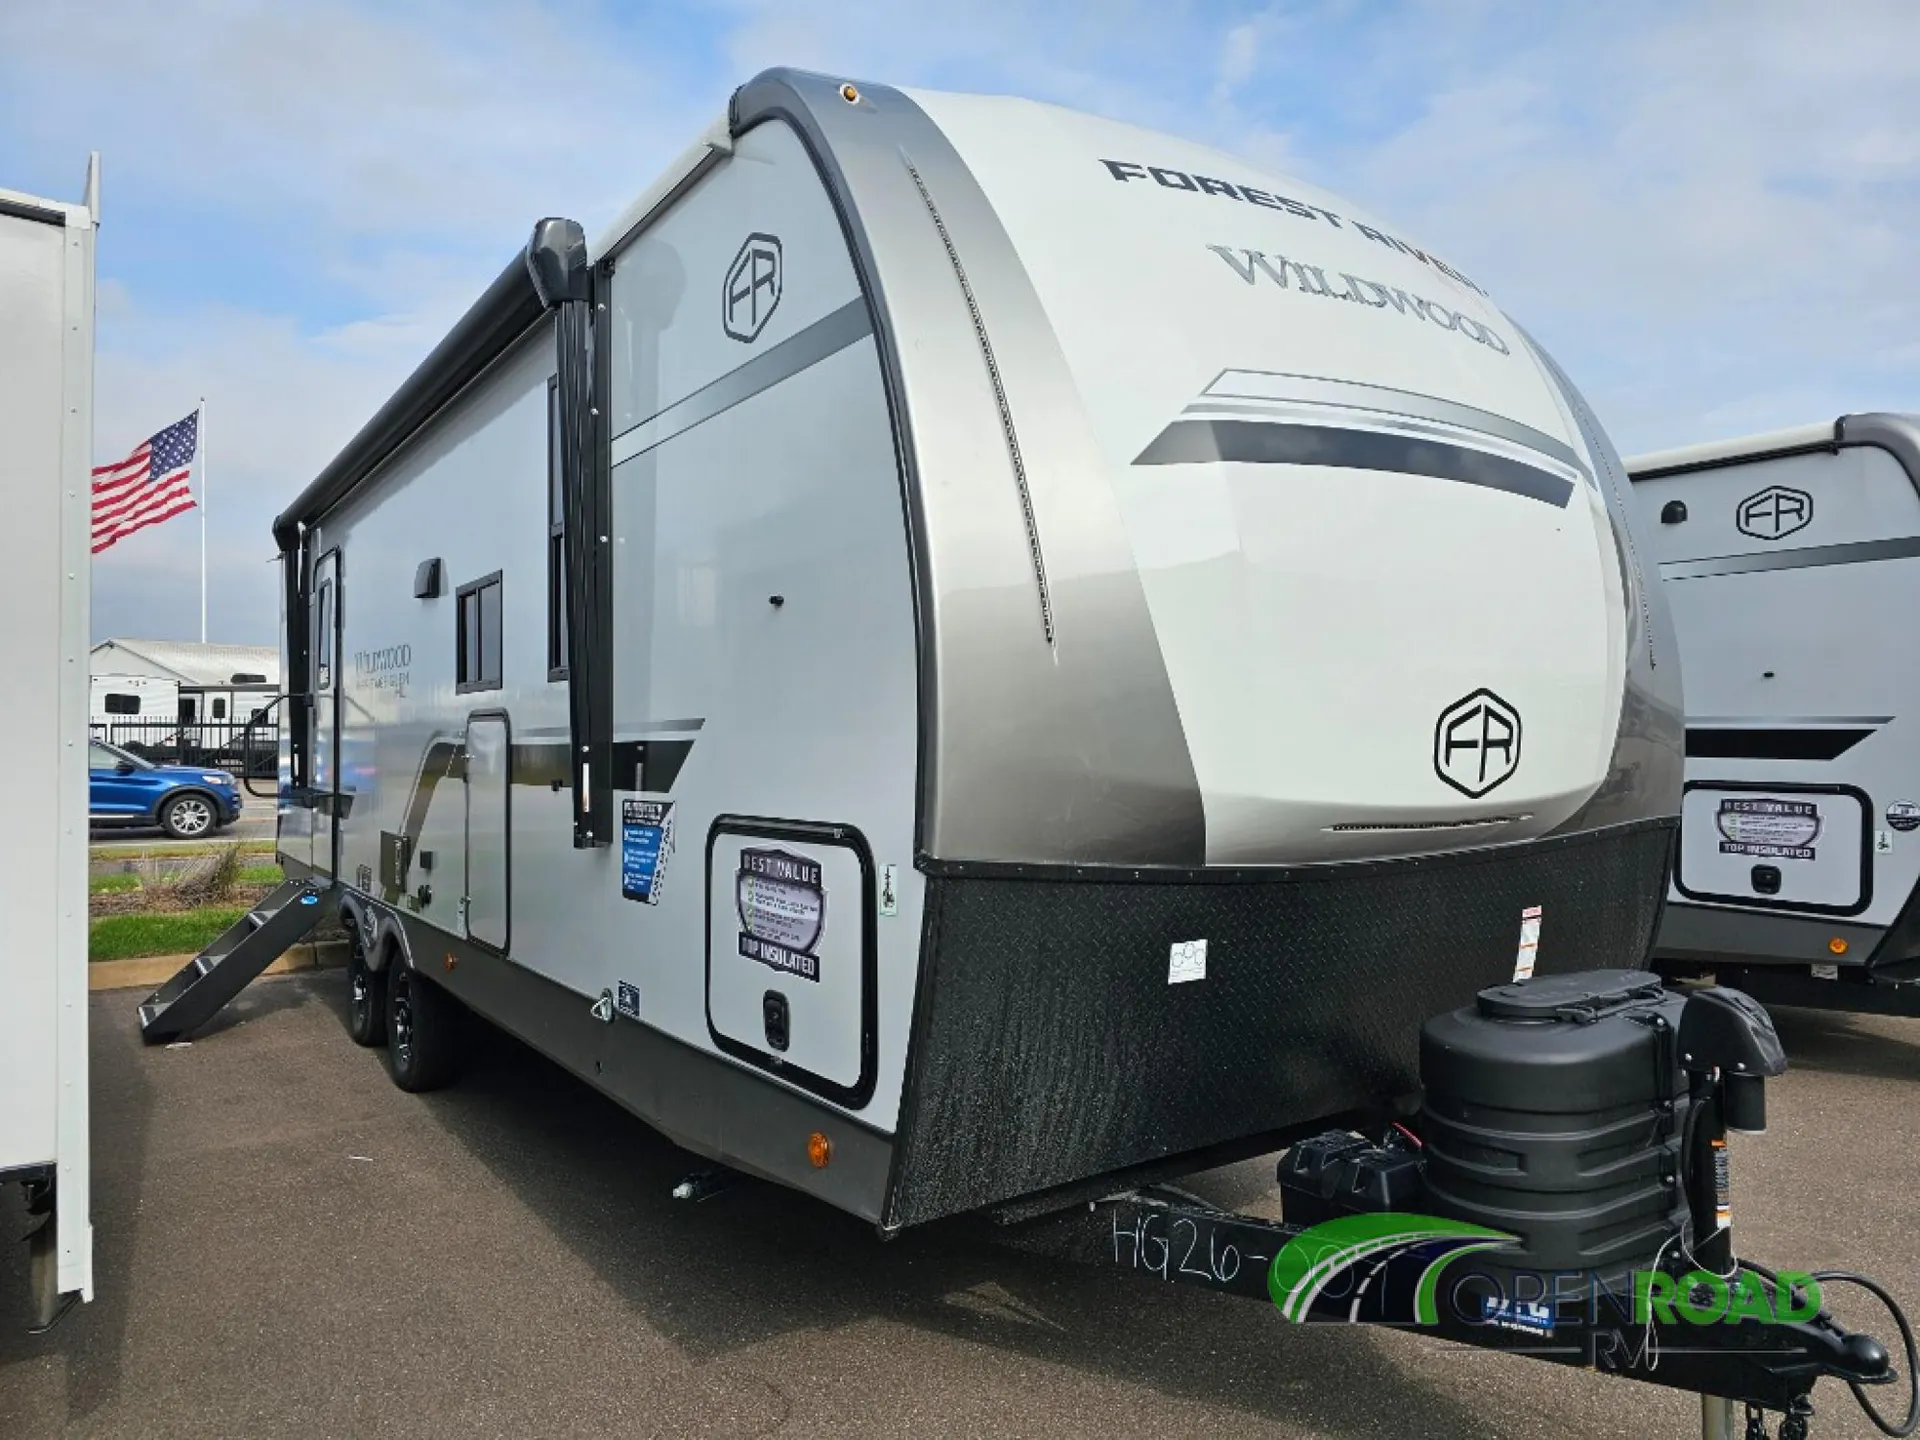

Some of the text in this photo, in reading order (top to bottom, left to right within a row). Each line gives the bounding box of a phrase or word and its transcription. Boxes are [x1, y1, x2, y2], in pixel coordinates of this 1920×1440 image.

[1098, 158, 1343, 228] FOREST
[1204, 243, 1511, 357] WILDWOOD
[777, 860, 819, 884] VALUE
[760, 941, 816, 976] INSULATED
